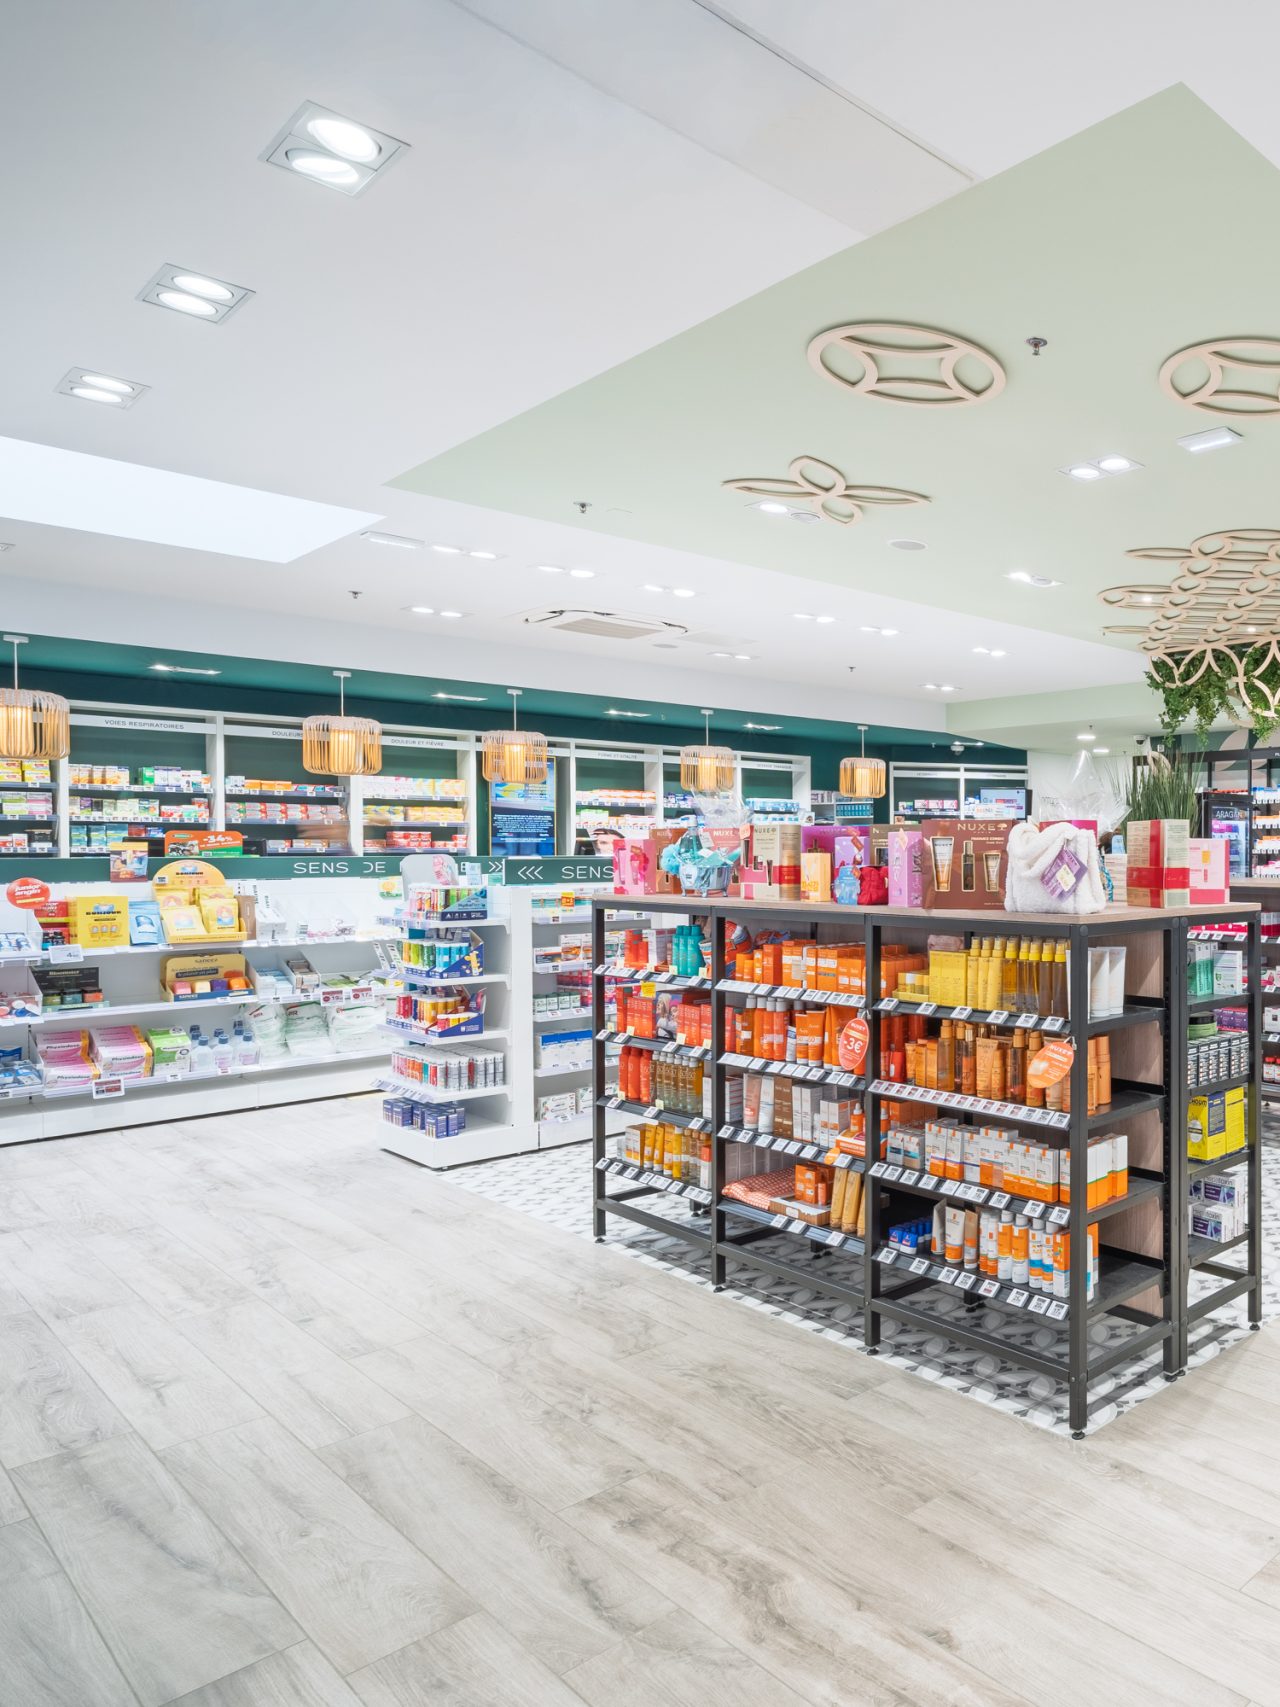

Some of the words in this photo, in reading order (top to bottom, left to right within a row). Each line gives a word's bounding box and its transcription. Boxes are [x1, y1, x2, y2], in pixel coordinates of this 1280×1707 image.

[957, 823, 996, 831] NUXE
[293, 861, 349, 874] SENS
[362, 861, 387, 874] DE
[561, 865, 614, 879] SENS
